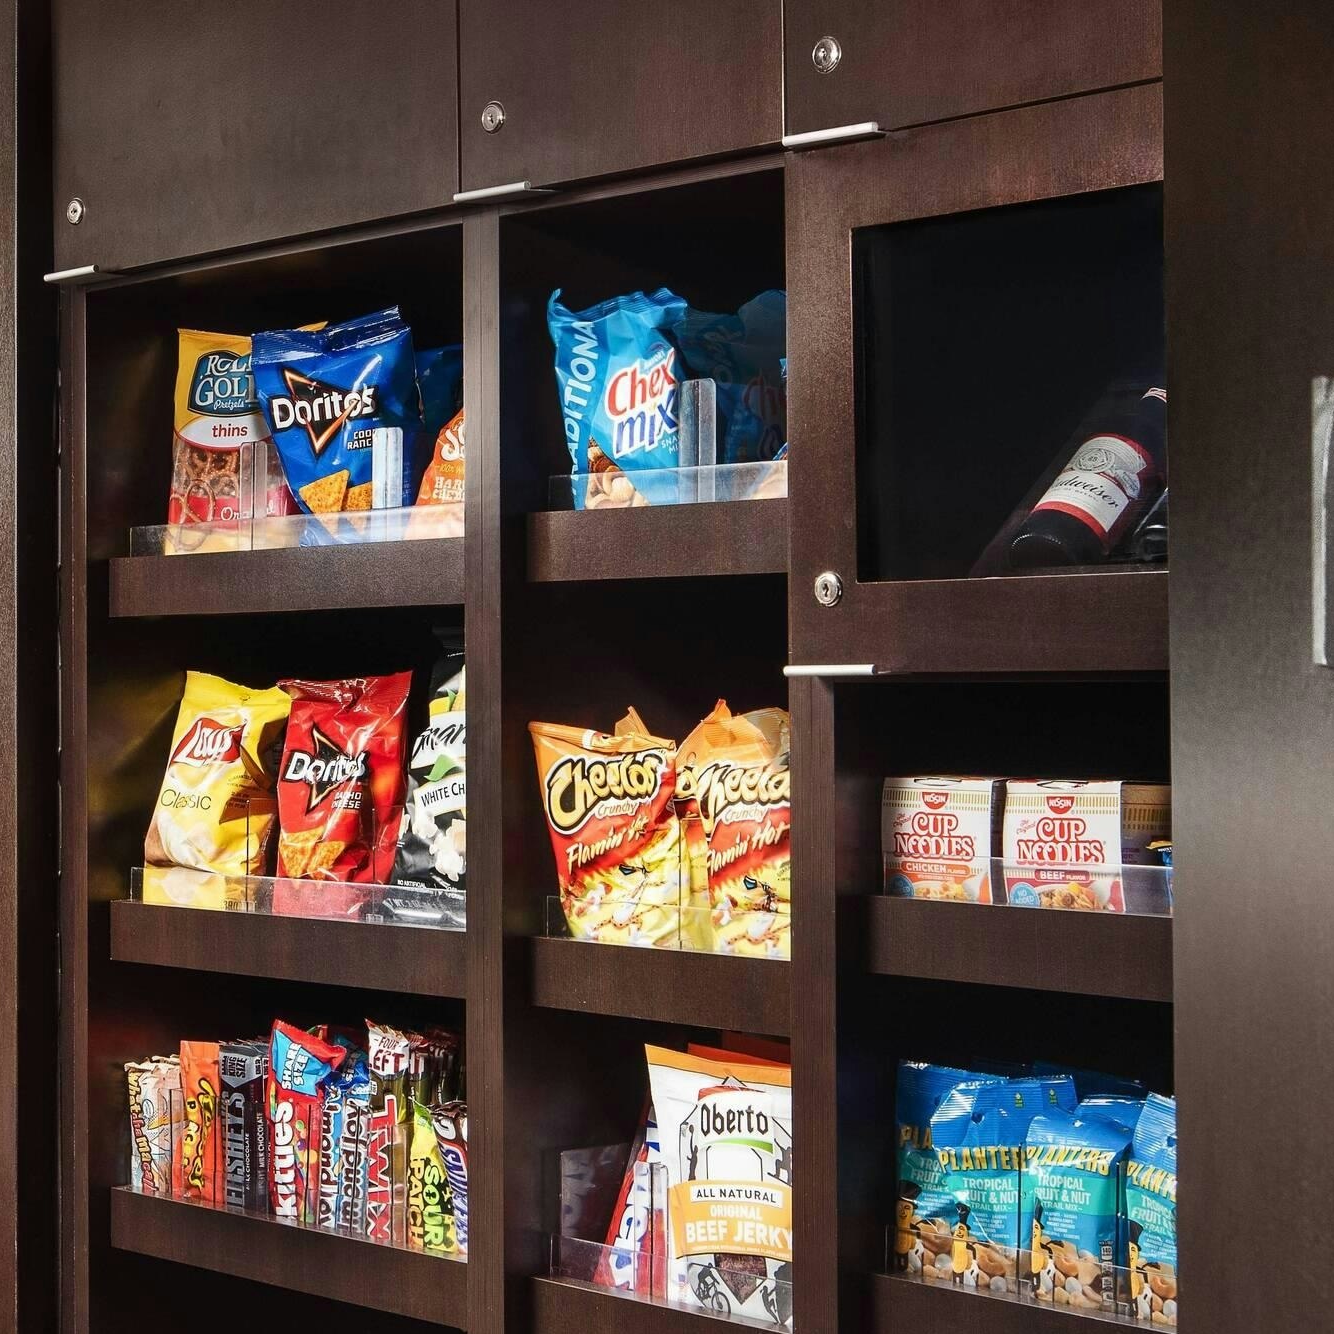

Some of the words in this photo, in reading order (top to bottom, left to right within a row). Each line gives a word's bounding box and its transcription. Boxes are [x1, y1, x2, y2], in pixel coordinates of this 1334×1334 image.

[605, 350, 677, 418] Chex
[213, 398, 246, 411] Pretzels
[271, 385, 378, 430] Doritos
[211, 423, 249, 438] thins
[353, 429, 373, 440] COO
[347, 438, 373, 450] RANC
[285, 751, 366, 783] Doritos
[420, 787, 450, 807] WHITE
[546, 751, 663, 832] Cheetos
[923, 792, 947, 804] NISSIN
[597, 802, 638, 817] Crunchy
[1048, 797, 1073, 808] NISSIN
[724, 804, 765, 823] Crunchy
[912, 812, 958, 836] CUP
[1036, 817, 1086, 841] CUP
[751, 820, 790, 849] Hot
[894, 834, 975, 860] NOODLES
[1017, 840, 1105, 866] NOODLES
[906, 862, 947, 874] CHICKEN
[1040, 870, 1065, 880] BEEF
[281, 1043, 302, 1090] SHARE
[292, 1054, 309, 1087] SIZE
[699, 1102, 768, 1137] Oberto
[257, 1112, 265, 1149] CHOCOLATE
[1027, 1146, 1113, 1176] PLANTERS
[963, 1177, 1014, 1191] TROPICAL
[1038, 1174, 1085, 1191] TROPICAL
[422, 1163, 445, 1247] SOUR
[696, 1188, 717, 1200] ALL
[719, 1188, 777, 1204] NATURAL
[989, 1191, 998, 1203] &
[1061, 1189, 1069, 1202] &
[1071, 1191, 1091, 1205] NUT
[710, 1203, 763, 1221] ORIGINAL
[685, 1221, 728, 1244] BEEF
[734, 1221, 792, 1250] JERKY
